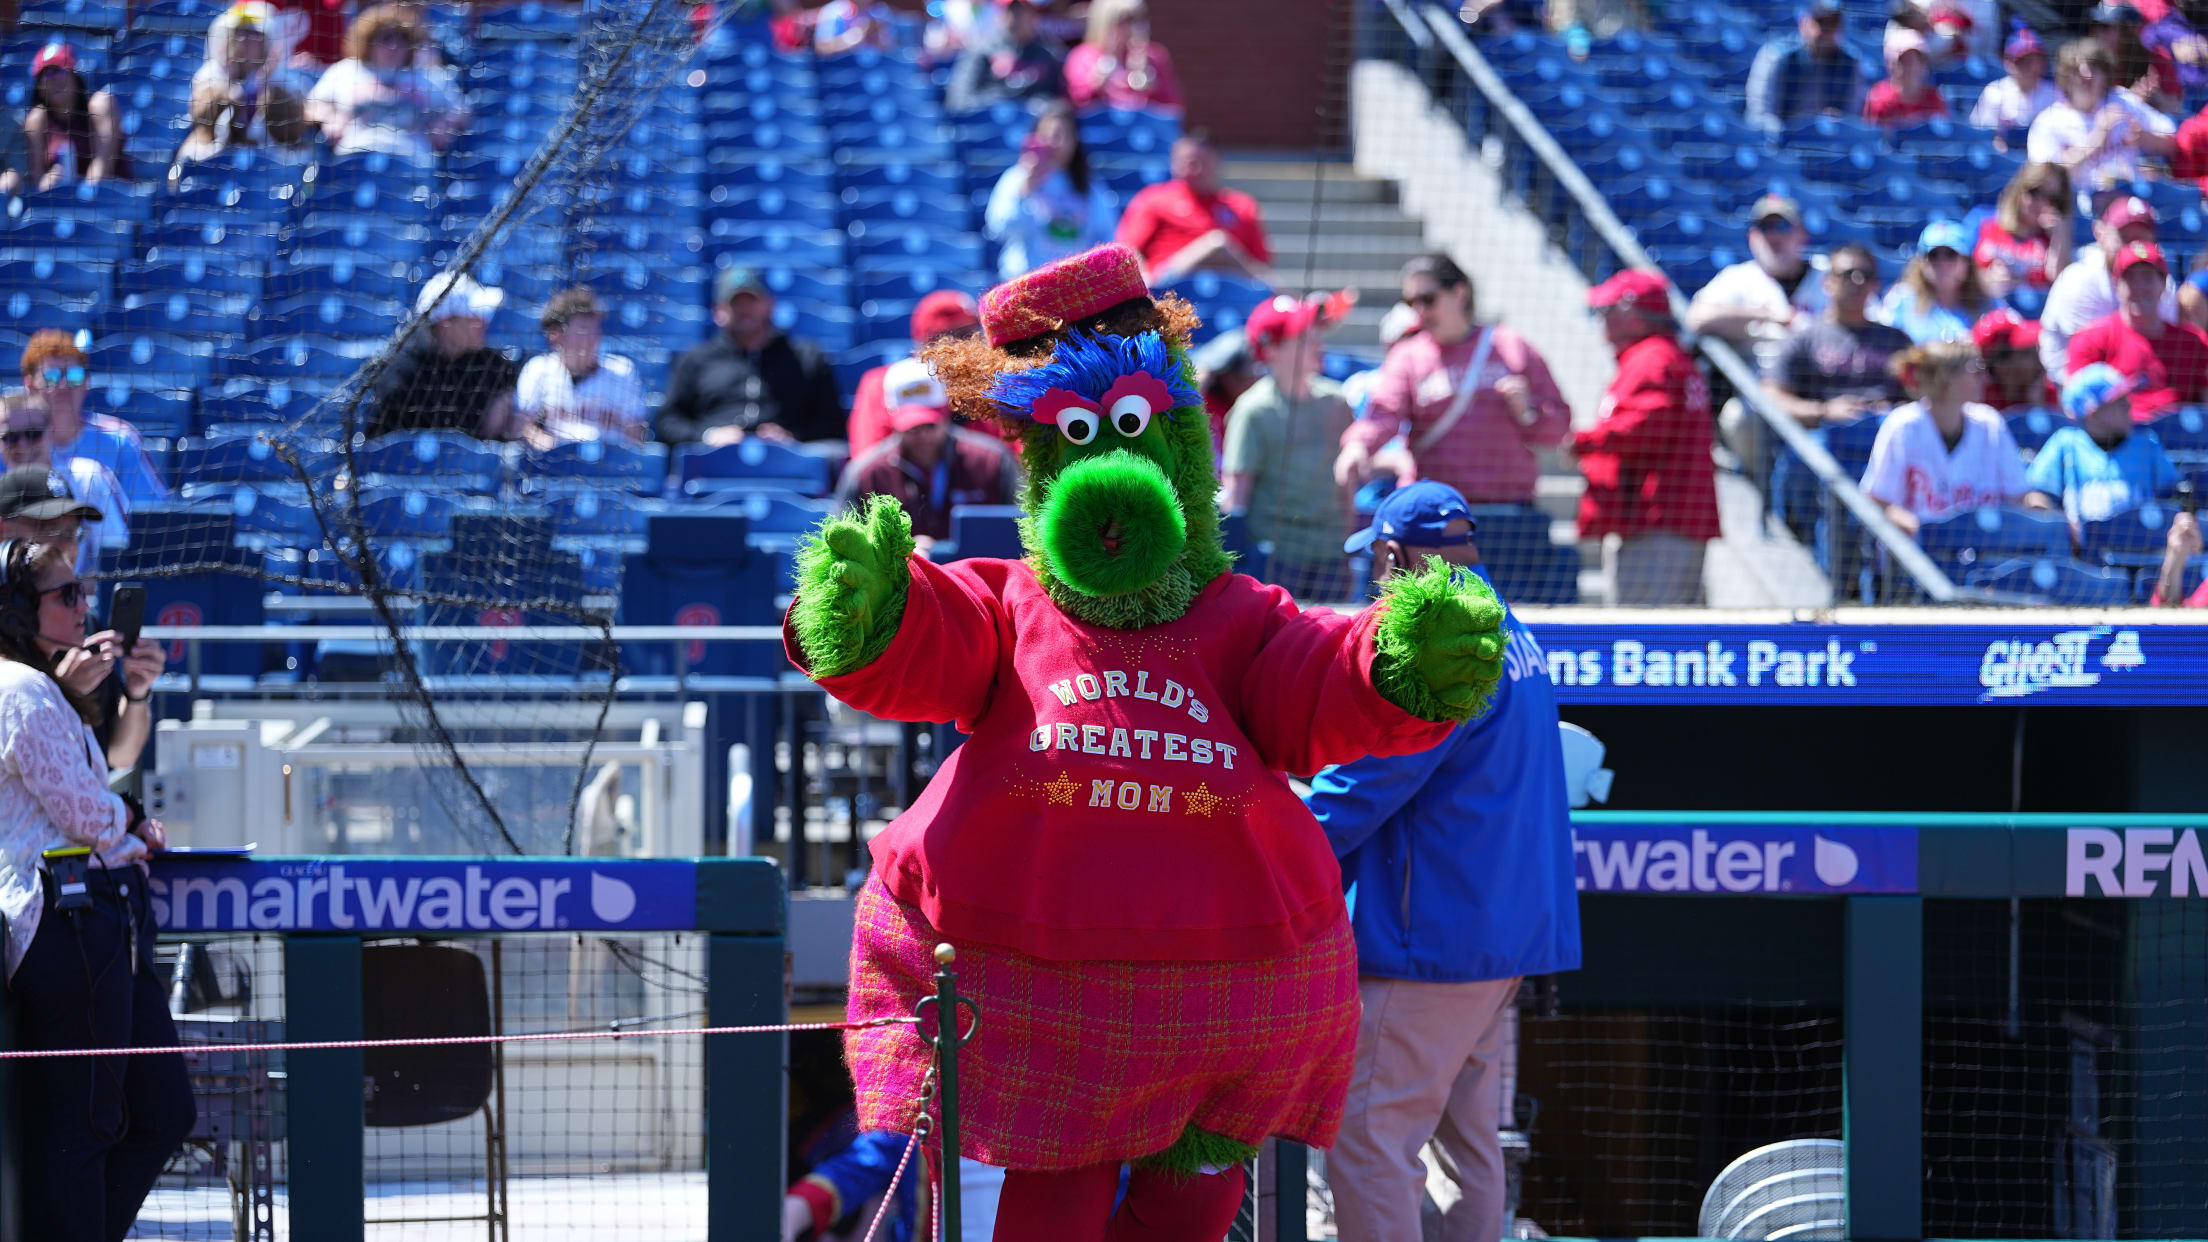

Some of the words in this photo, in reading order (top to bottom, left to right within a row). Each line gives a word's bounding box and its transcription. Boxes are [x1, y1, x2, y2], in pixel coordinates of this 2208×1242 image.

[1612, 640, 1738, 687] Bank
[1747, 637, 1858, 687] Park
[1048, 670, 1209, 723] WORLD'S
[1029, 722, 1238, 769] GREATEST
[1088, 779, 1173, 812] MOM
